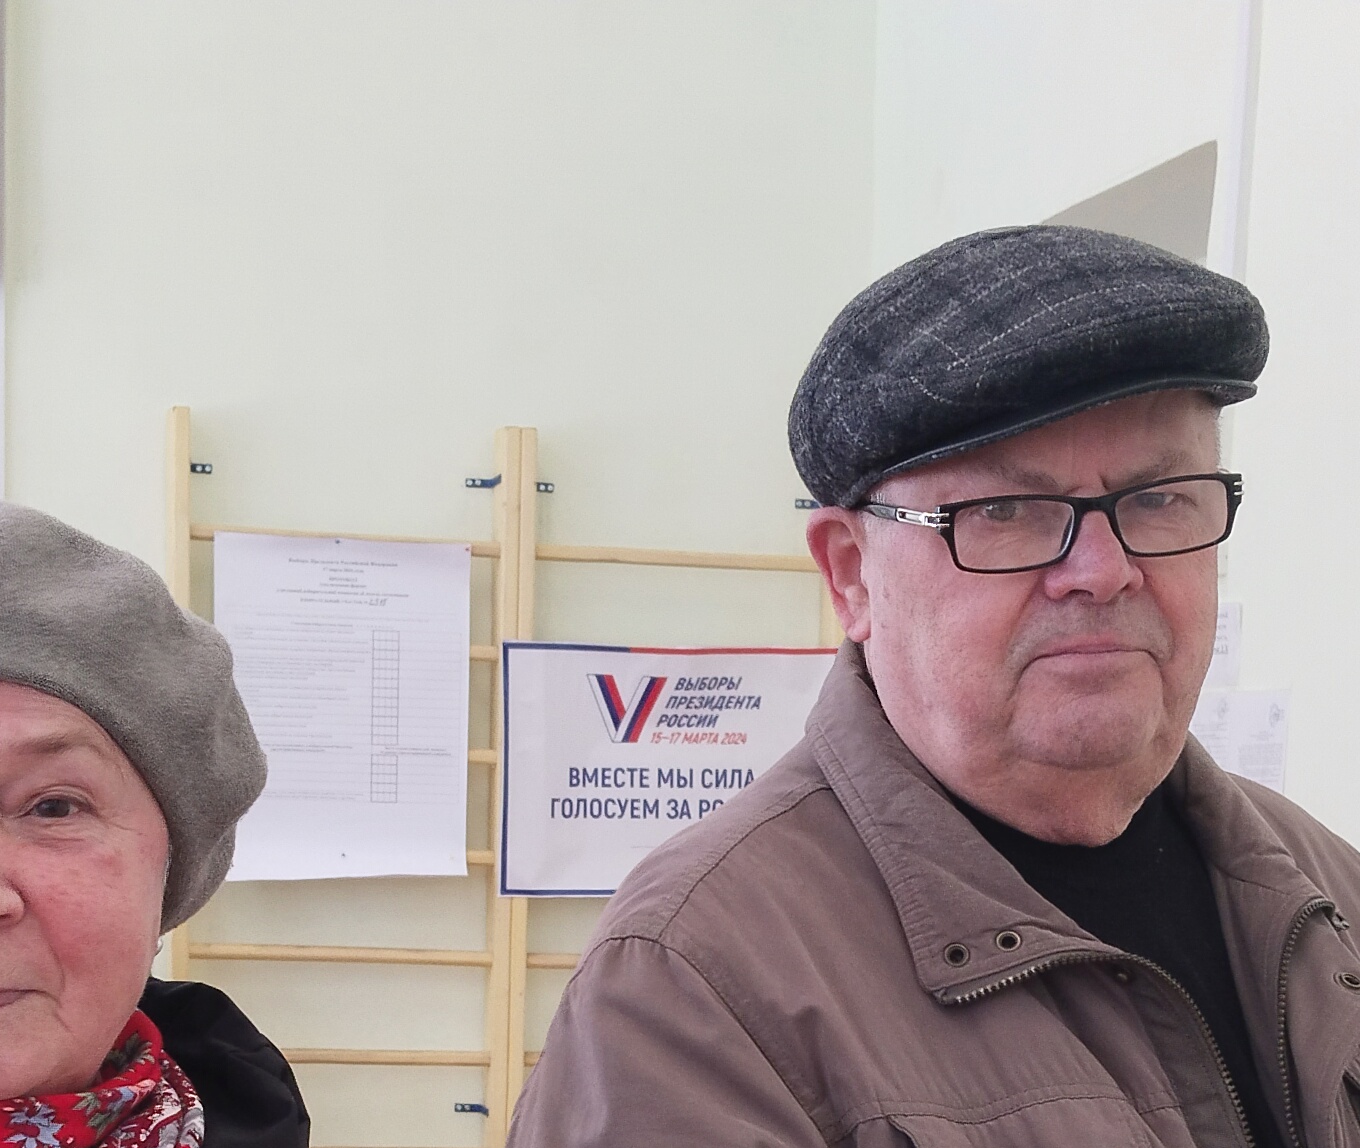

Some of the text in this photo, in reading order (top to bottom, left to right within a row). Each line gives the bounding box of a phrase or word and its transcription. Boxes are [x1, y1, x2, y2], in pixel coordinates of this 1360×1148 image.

[674, 676, 743, 691] ВЫБОРЫ
[665, 695, 762, 711] ПРЕЗИДЕНТА
[656, 713, 719, 728] РОССИИ
[681, 732, 719, 744] МАРТА
[720, 732, 748, 745] 2024
[568, 767, 755, 789] ВМЕСТЕ МЫ СИЛА
[551, 797, 659, 820] ГОЛОСУЕМ
[666, 799, 692, 820] ЗА
